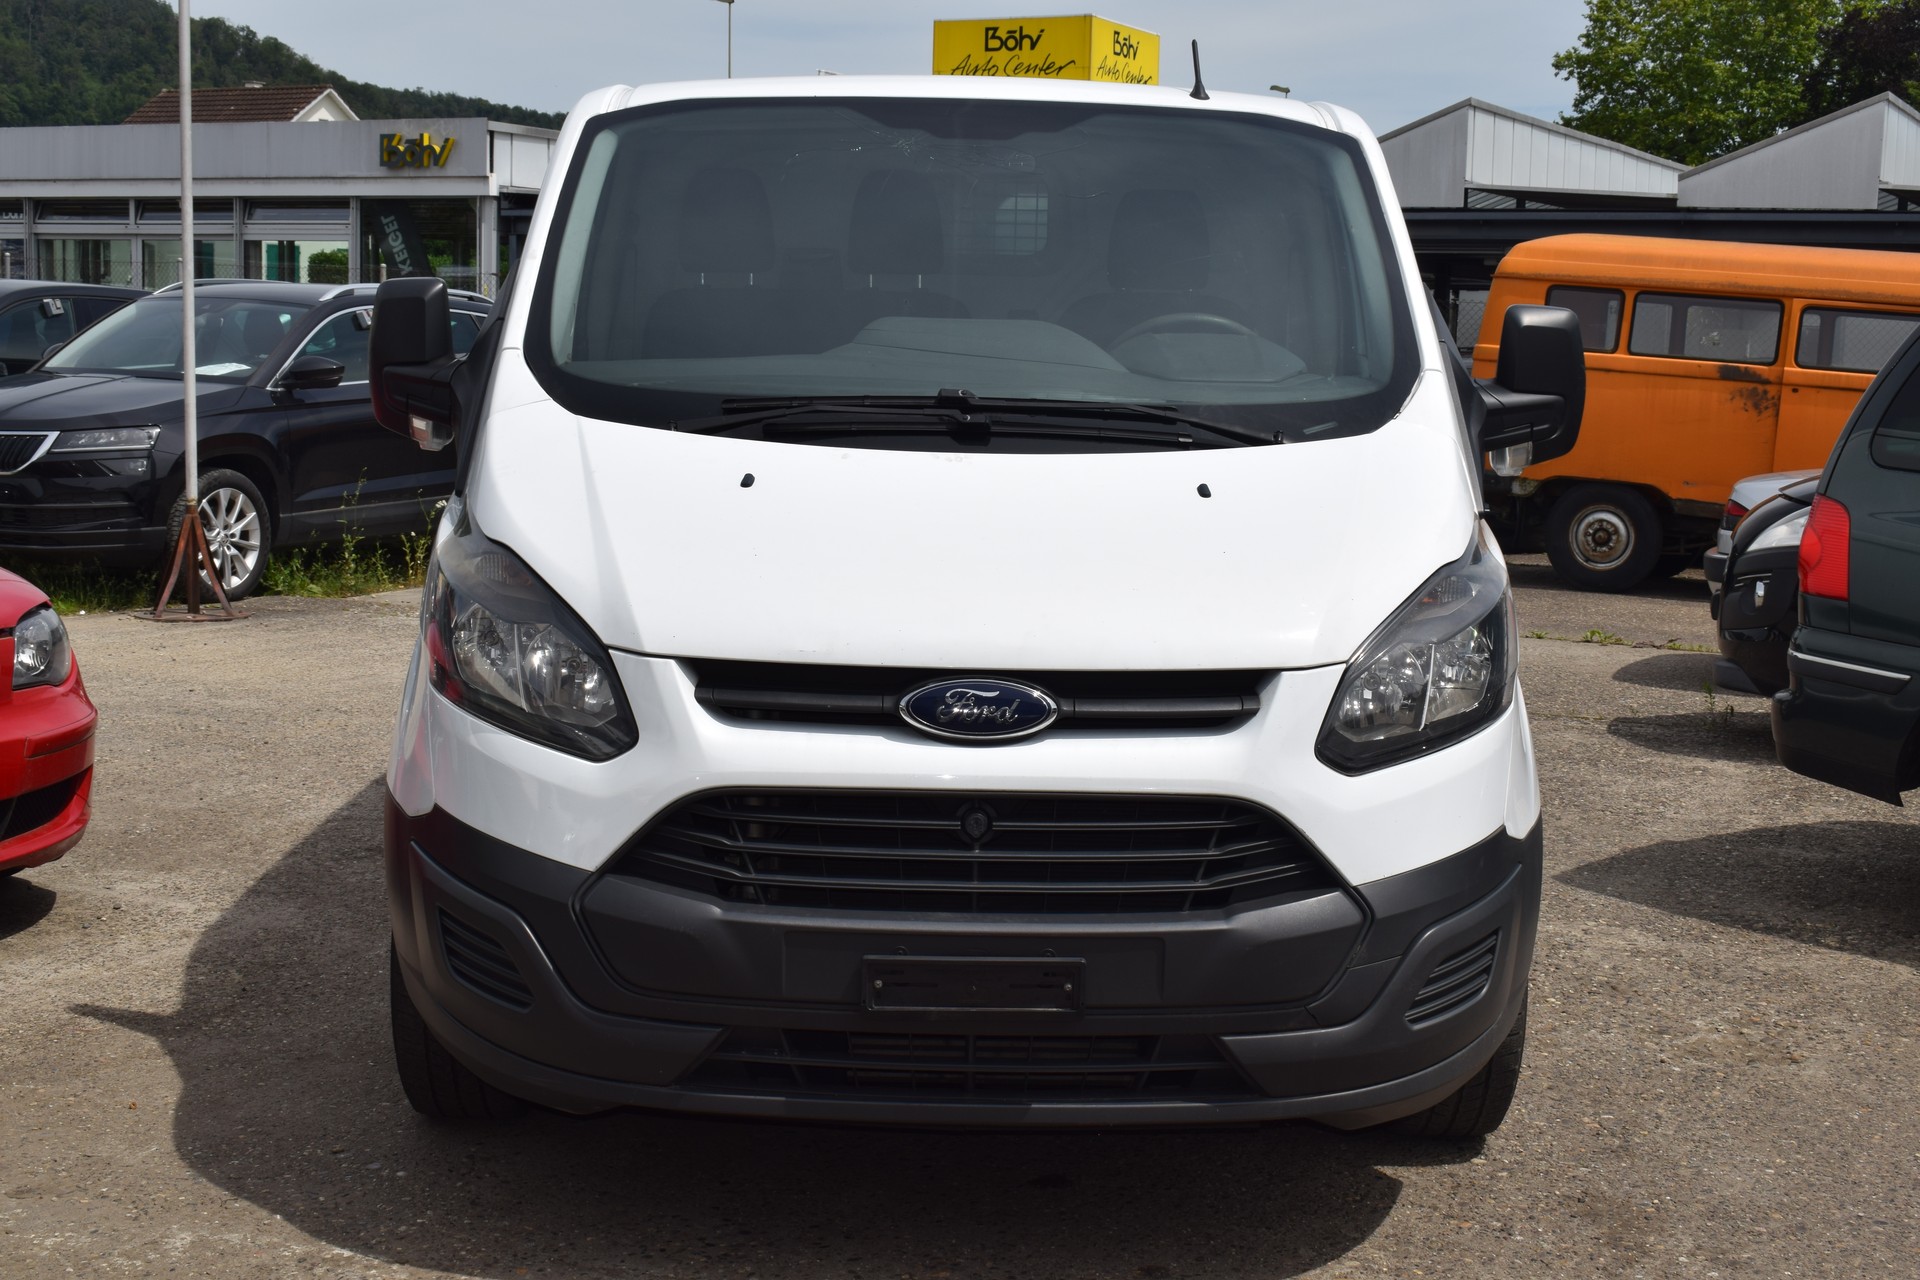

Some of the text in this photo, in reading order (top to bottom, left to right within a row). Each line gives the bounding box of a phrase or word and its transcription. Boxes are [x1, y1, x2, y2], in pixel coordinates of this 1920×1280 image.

[951, 53, 1076, 77] Auto Center
[1096, 55, 1121, 81] Auto
[935, 688, 1021, 724] Ford
